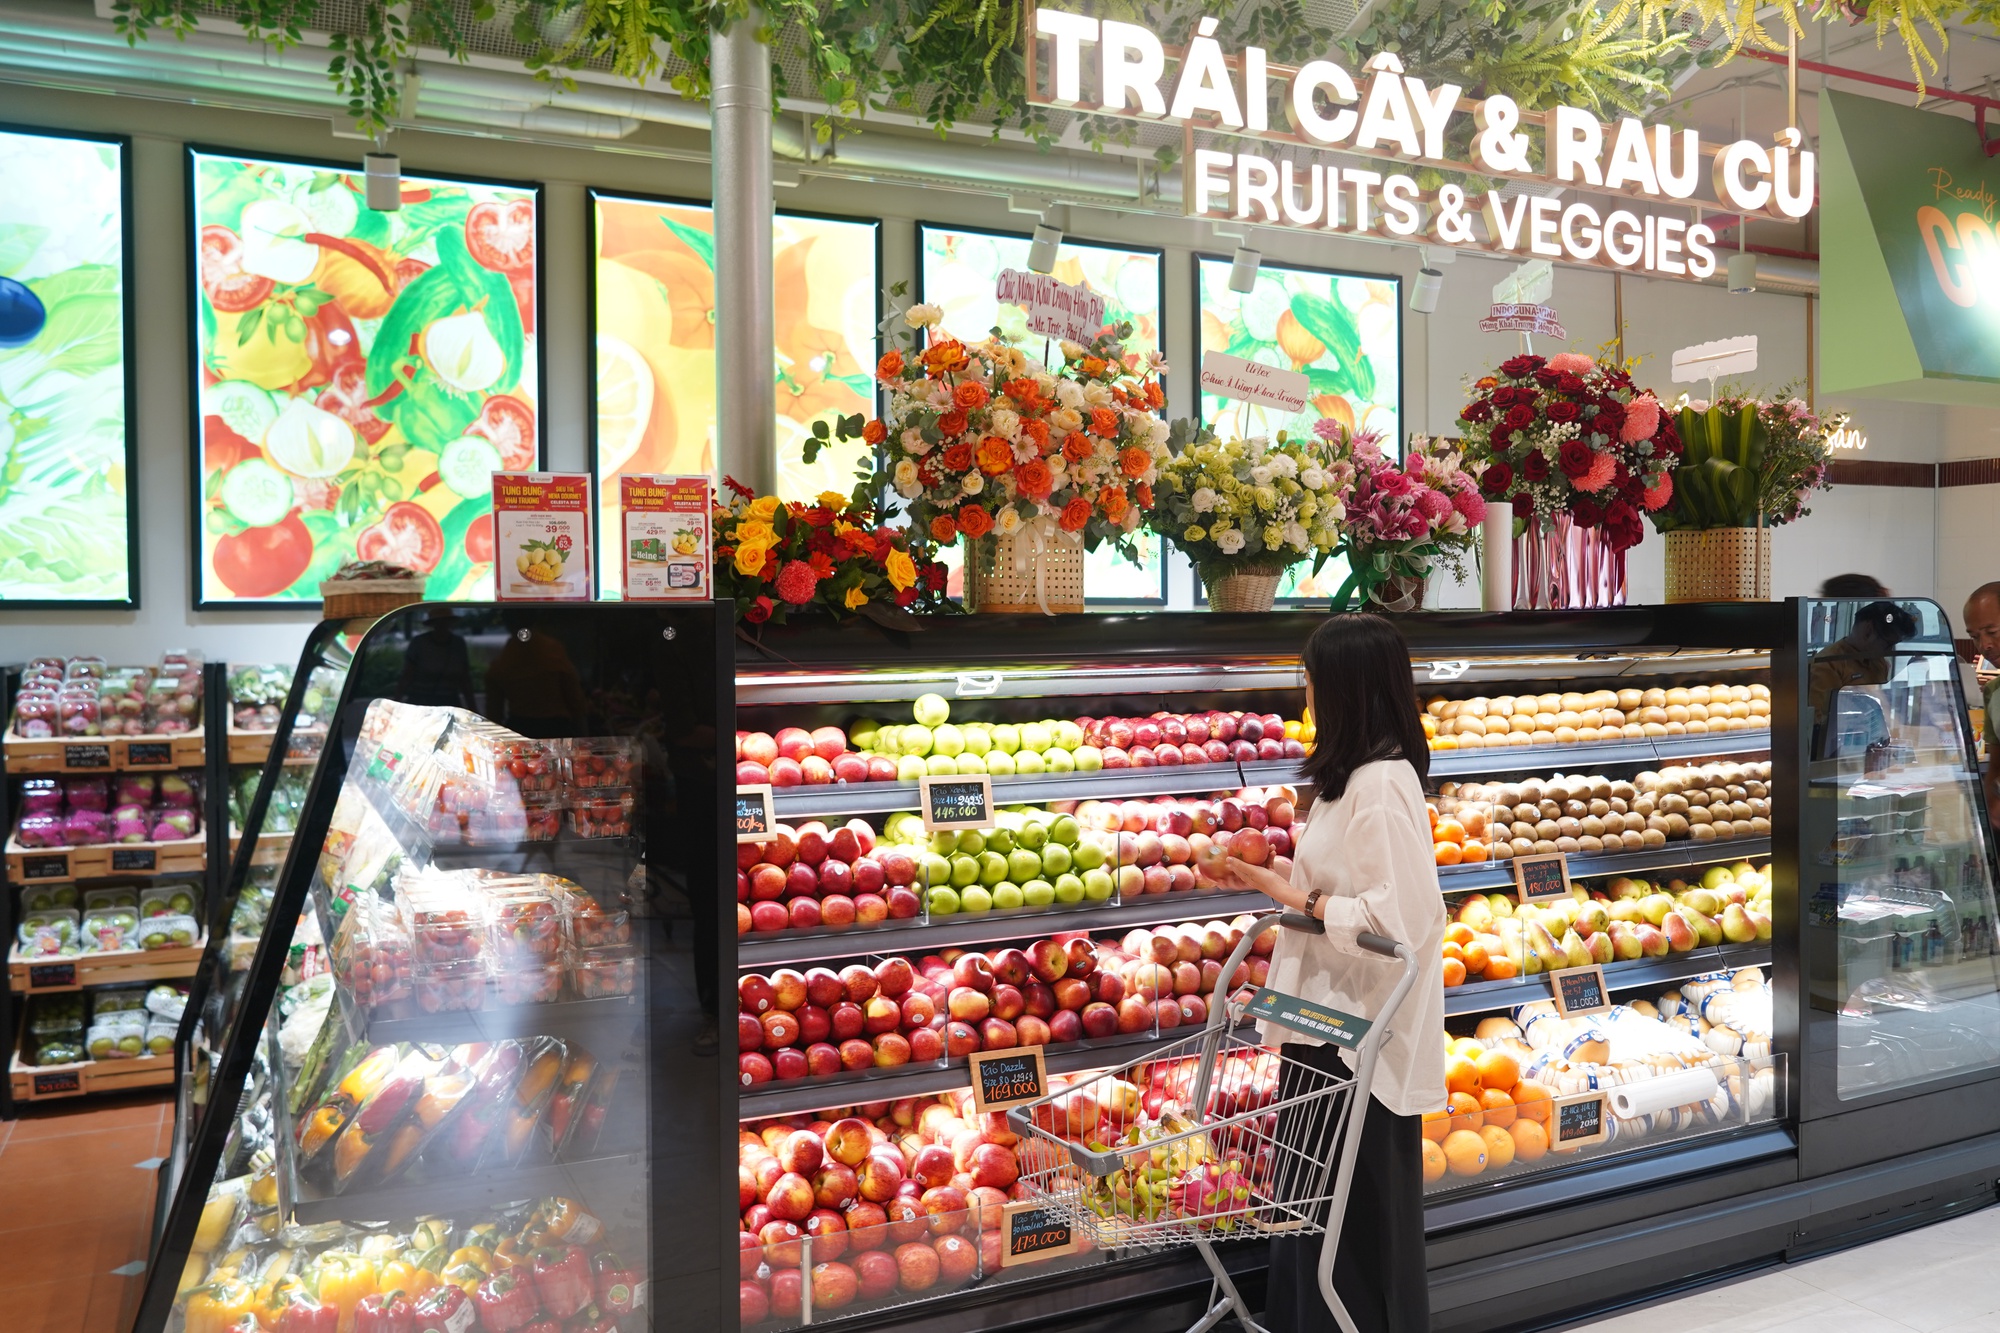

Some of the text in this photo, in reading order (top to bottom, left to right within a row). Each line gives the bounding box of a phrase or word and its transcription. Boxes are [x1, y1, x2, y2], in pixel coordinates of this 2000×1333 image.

[1036, 8, 1814, 217] TRÁI CÂY & RAU CỦ
[1927, 167, 1999, 224] Ready
[1195, 148, 1716, 278] FRUITS & VEGGIES
[997, 271, 1016, 301] Chúc
[1014, 274, 1035, 311] Mừng
[1036, 277, 1051, 306] Khai
[1051, 282, 1073, 321] Trương
[1073, 281, 1089, 328] Hồng
[1492, 306, 1557, 320] INDOGUNA-VINA
[1034, 315, 1046, 332] Mr.
[1047, 317, 1061, 339] Trực
[545, 525, 557, 533] 39
[636, 551, 658, 561] Heine
[1308, 1010, 1330, 1022] LIFESTYLE
[1326, 1016, 1345, 1027] MARKET
[1000, 1059, 1027, 1074] Dazzle
[985, 1081, 1038, 1101] 169.000
[1011, 1229, 1067, 1253] 179.000
